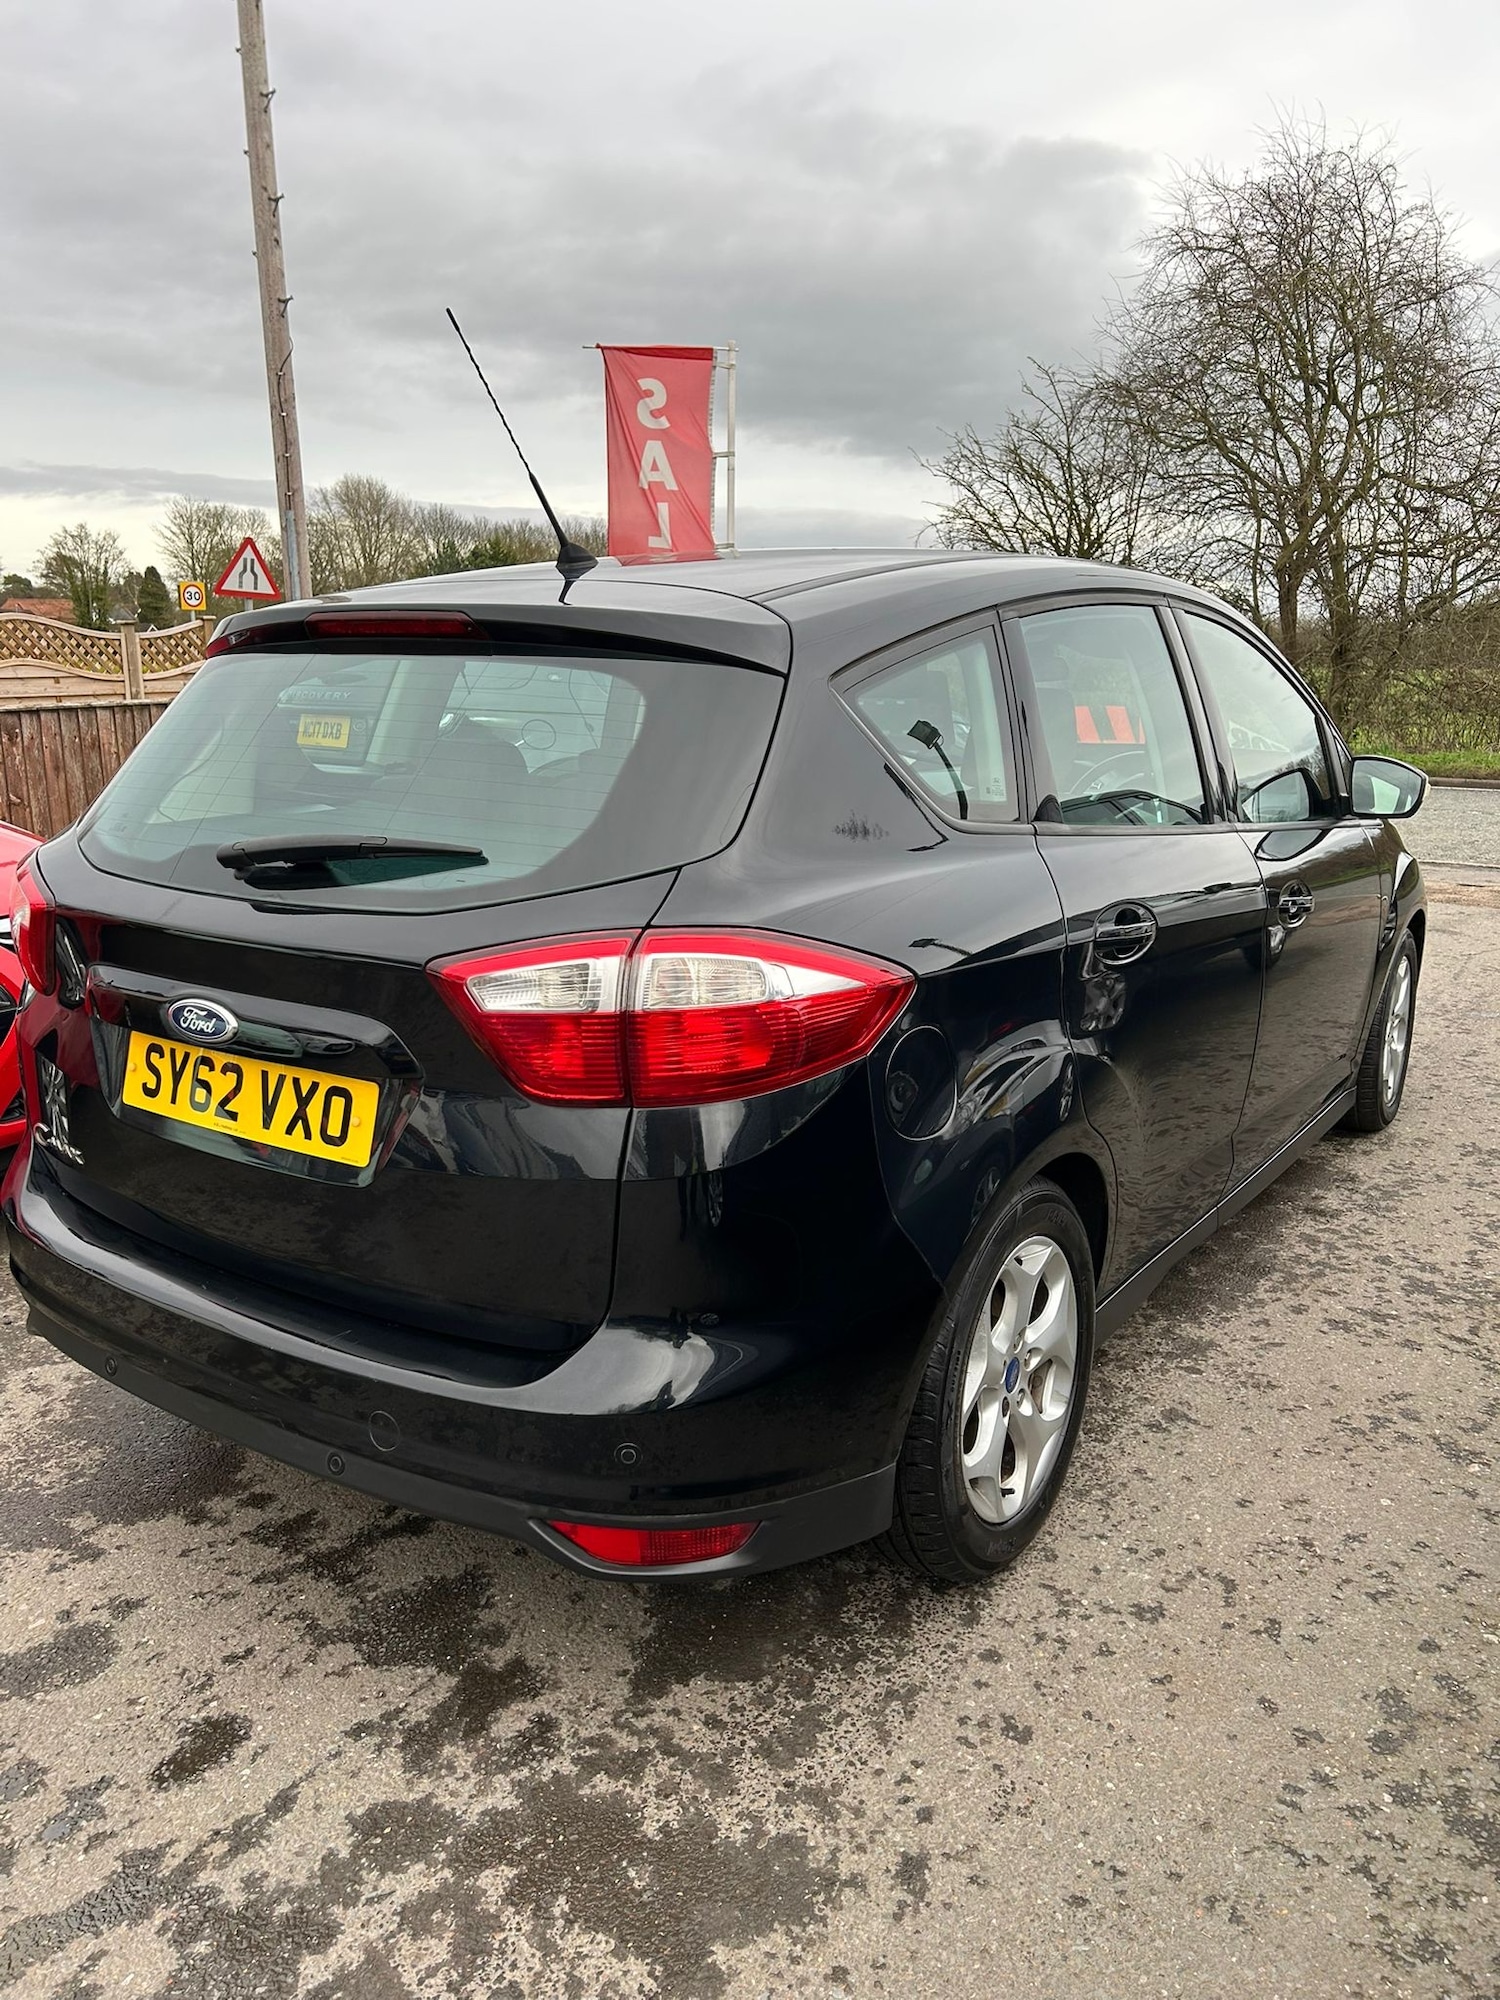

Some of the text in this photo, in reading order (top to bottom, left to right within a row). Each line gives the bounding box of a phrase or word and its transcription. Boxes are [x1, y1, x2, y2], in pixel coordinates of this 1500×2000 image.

[186, 590, 201, 601] 30
[322, 722, 343, 740] DXB
[180, 1006, 217, 1034] Ford
[142, 1042, 353, 1147] SY62 VXO
